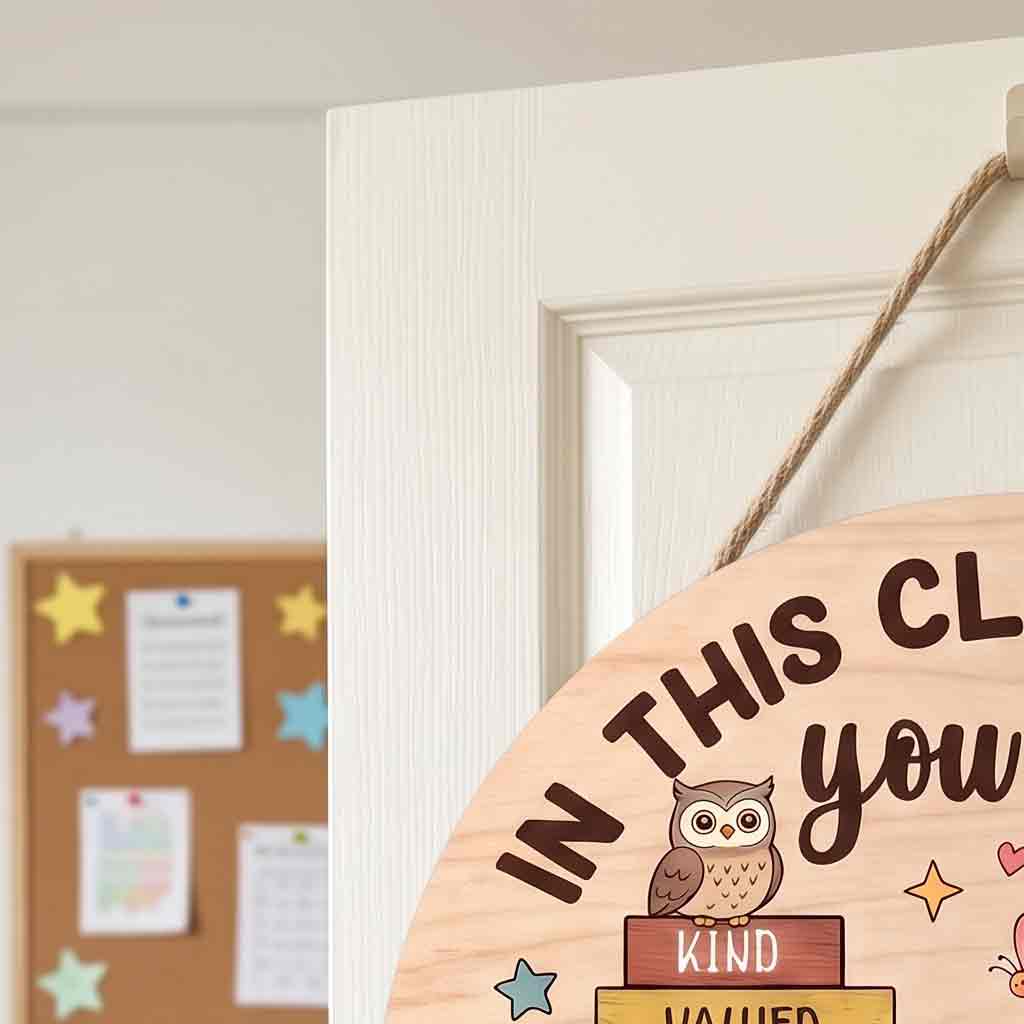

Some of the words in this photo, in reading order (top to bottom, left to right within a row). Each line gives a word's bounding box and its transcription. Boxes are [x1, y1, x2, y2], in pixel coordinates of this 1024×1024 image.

[495, 781, 625, 905] IN
[601, 595, 842, 780] THIS
[801, 716, 1021, 865] you
[676, 928, 779, 974] KIND
